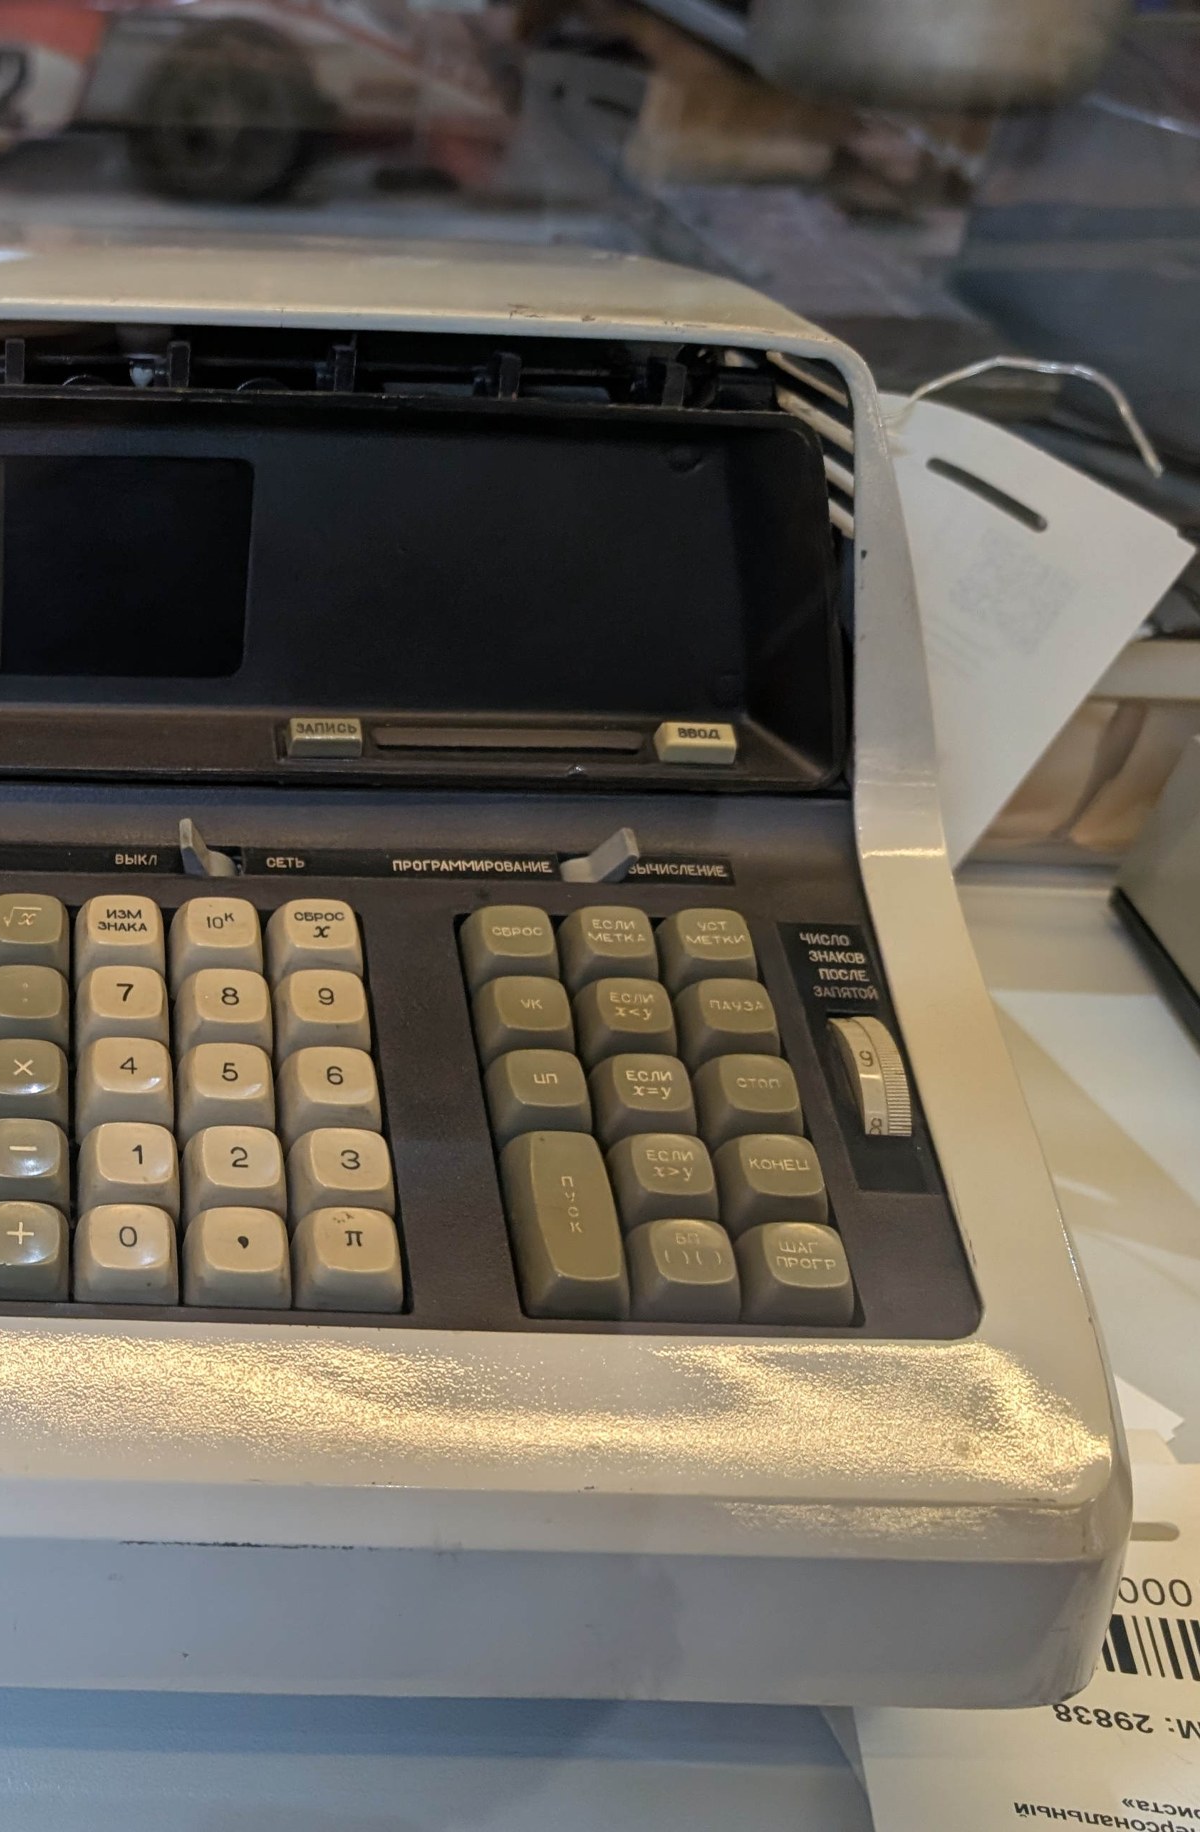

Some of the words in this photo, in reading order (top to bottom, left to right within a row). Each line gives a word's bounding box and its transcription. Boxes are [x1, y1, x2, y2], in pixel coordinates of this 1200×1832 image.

[296, 722, 357, 735] ЗАПИСЬ
[677, 726, 721, 740] ВВОД
[114, 852, 158, 866] ВЫКЛ
[266, 856, 305, 869] СЕТЬ
[392, 858, 553, 874] ПРОГРАММИРОВАНИЕ
[105, 908, 143, 920] ИЗМ
[293, 911, 346, 923] СБРОС
[97, 921, 149, 933] ЗНАКА
[591, 918, 636, 930] ЕСЛИ
[696, 919, 728, 932] УСТ
[491, 926, 544, 937] СБРОС
[587, 931, 646, 943] МЕТКА
[685, 934, 746, 946] МЕТКИ
[799, 932, 850, 947] ЧИСЛО
[808, 950, 866, 965] ЗНАКОВ
[818, 968, 870, 983] ПОСЛЕ
[116, 983, 135, 1002] 7
[220, 987, 240, 1006] 8
[318, 987, 336, 1006] 9
[609, 992, 654, 1004] ЕСЛИ
[812, 985, 879, 1000] ЗАПЯТОЙ
[708, 999, 765, 1012] ПАУЗА
[119, 1056, 138, 1075] 4
[221, 1062, 240, 1082] 5
[326, 1066, 345, 1086] 6
[533, 1072, 559, 1085] ЦП
[625, 1069, 673, 1083] ЕСЛИ
[735, 1076, 781, 1089] СТОП
[131, 1144, 144, 1165] 1
[230, 1146, 249, 1168] 2
[340, 1149, 361, 1170] 3
[646, 1149, 694, 1162] ЕСЛИ
[749, 1158, 811, 1172] КОНЕЦ
[119, 1226, 138, 1248] 0
[778, 1240, 818, 1253] ШАГ
[775, 1256, 837, 1270] ПРОГР
[1054, 1703, 1155, 1734] 29838
